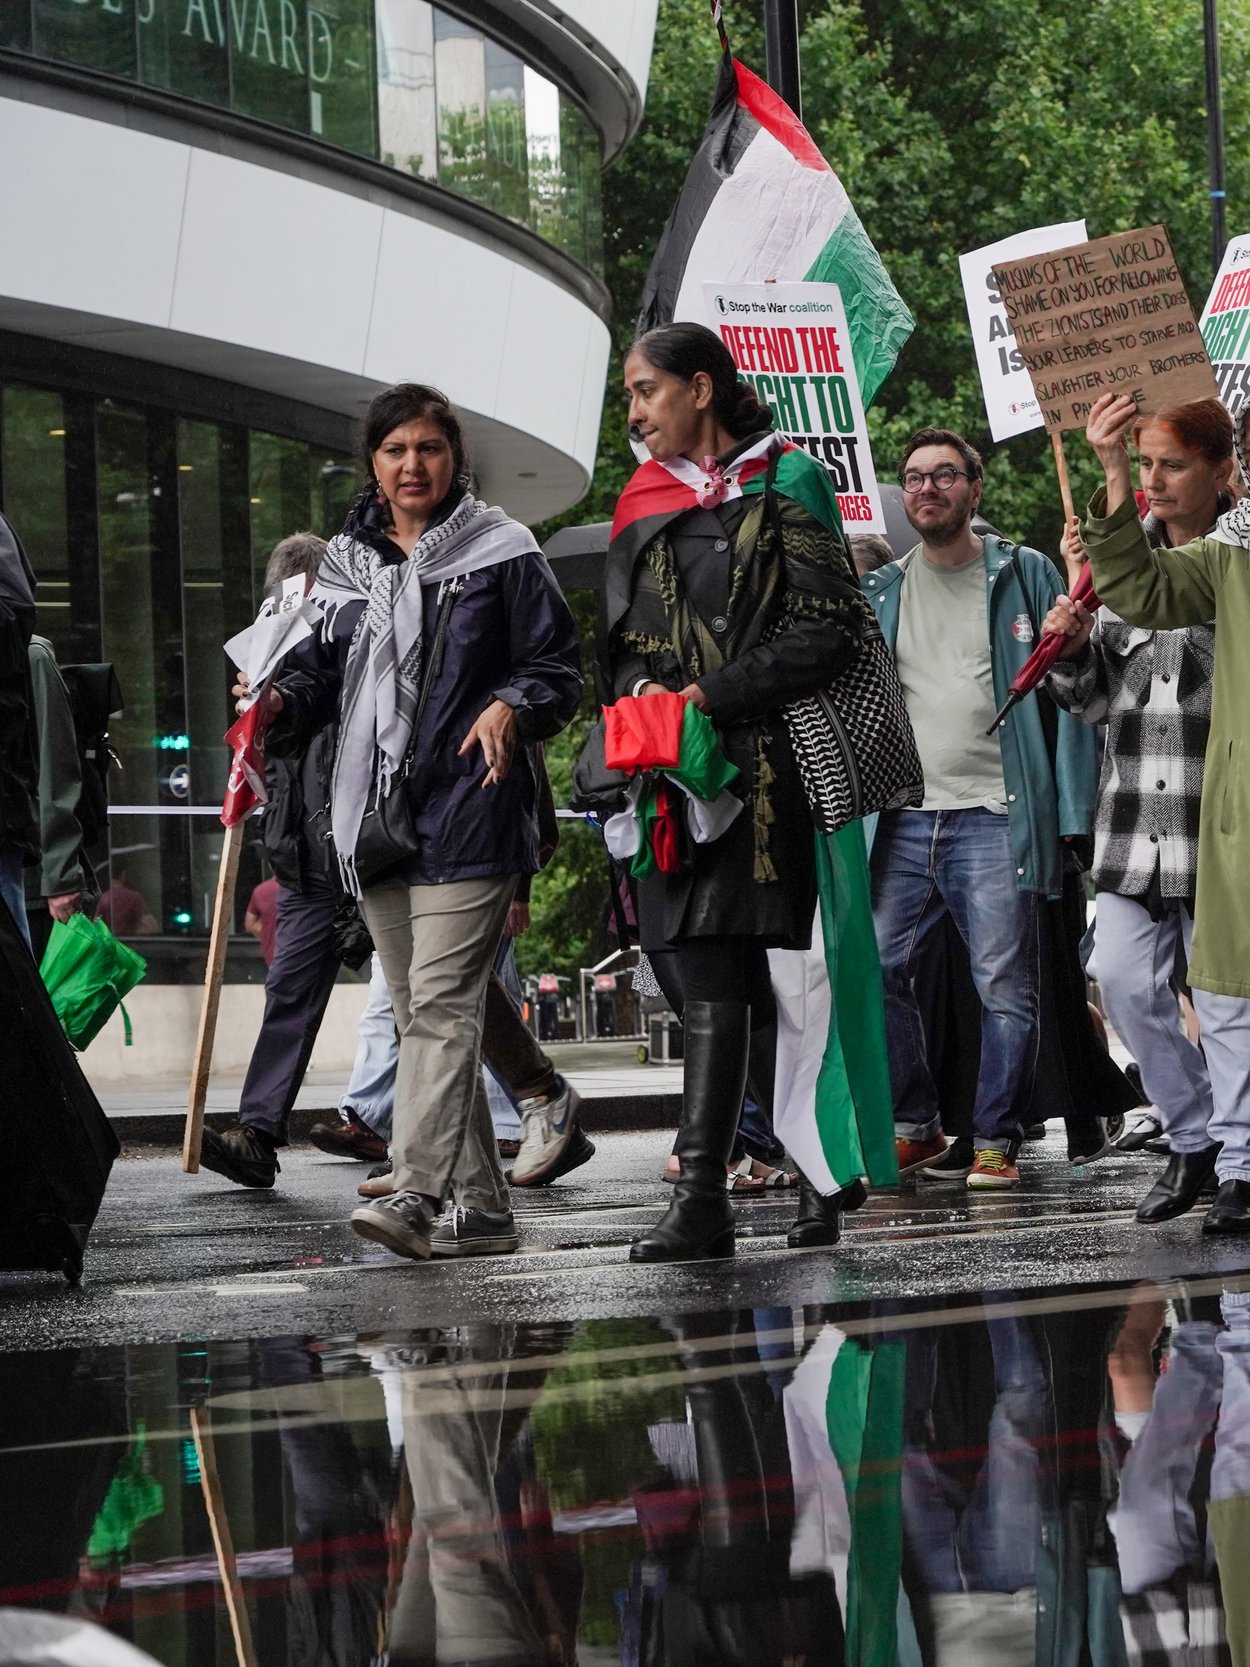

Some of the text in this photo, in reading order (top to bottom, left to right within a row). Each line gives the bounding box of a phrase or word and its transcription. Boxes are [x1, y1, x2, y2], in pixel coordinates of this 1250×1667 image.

[994, 237, 1166, 294] MUSLIMS OF THE WORLD
[728, 301, 833, 315] Stop the War coalition
[1004, 288, 1052, 320] SHAME
[1050, 286, 1071, 308] ON
[1069, 279, 1096, 303] YOU
[1093, 275, 1121, 297] FOR
[1013, 320, 1046, 345] THE
[1046, 308, 1105, 338] ZIONISTS
[1103, 302, 1129, 324] AND
[1127, 295, 1164, 318] THEIR
[719, 324, 845, 374] DEFEND THE
[1021, 320, 1196, 372] YOUR LEADERS TO STARVE AND
[1036, 351, 1207, 402] SLAUGHTER YOUR BROTHERS
[738, 374, 855, 434] GHT TO
[1020, 400, 1037, 411] Stop
[1046, 408, 1062, 426] IN
